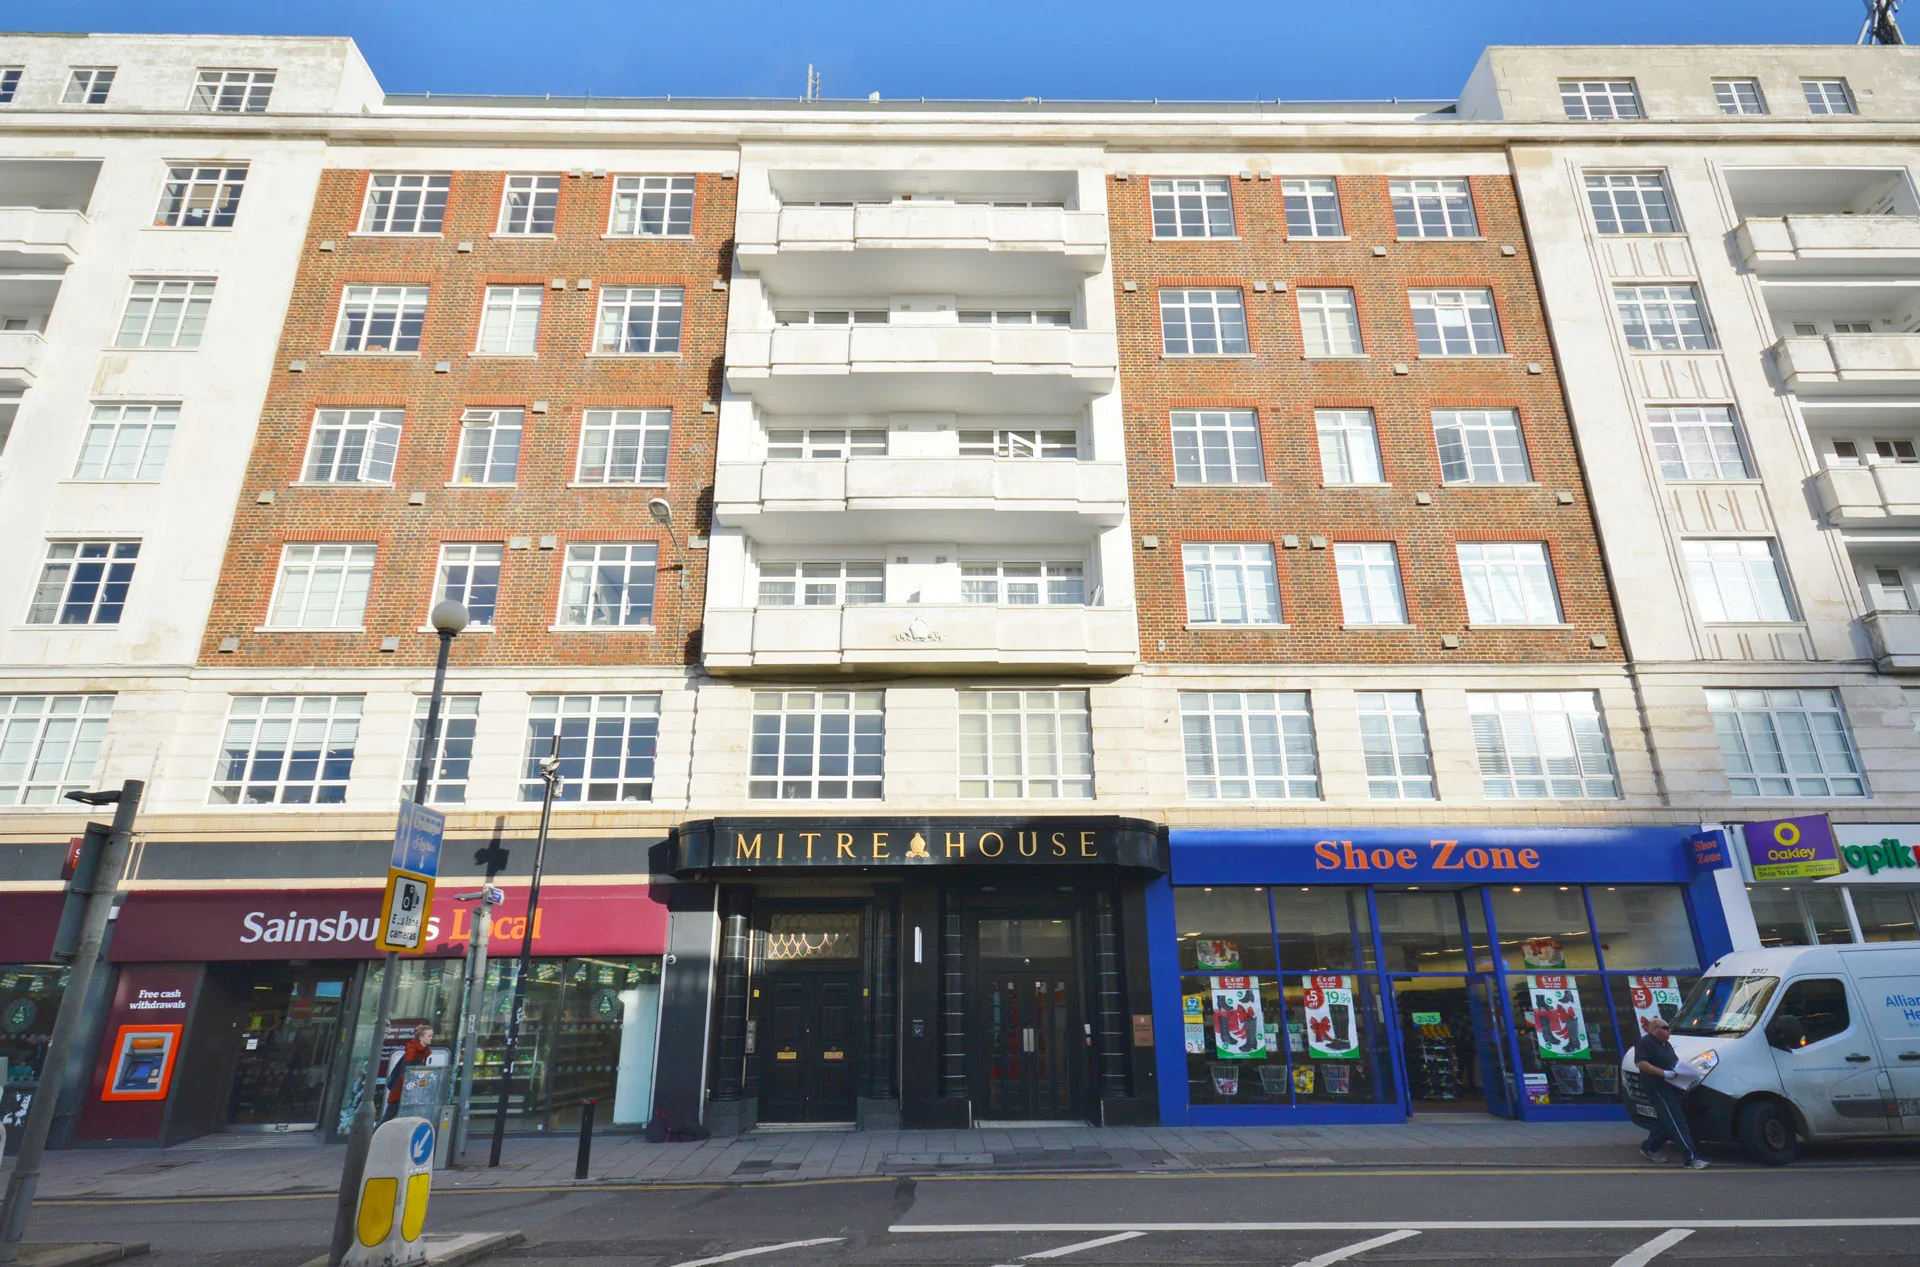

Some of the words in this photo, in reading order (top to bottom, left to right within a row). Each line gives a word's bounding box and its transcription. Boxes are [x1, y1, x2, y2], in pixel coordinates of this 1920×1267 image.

[736, 832, 890, 860] MITRE
[944, 831, 1099, 859] HOUSE
[1694, 840, 1719, 851] Shoe
[1314, 840, 1418, 870] Shoe
[1429, 840, 1540, 869] Zone
[1696, 852, 1722, 865] Zone
[1767, 847, 1816, 861] Oakley
[1758, 870, 1777, 878] Shop
[240, 910, 440, 943] Sainsbus
[449, 908, 543, 941] Lcal
[138, 989, 159, 999] Free
[160, 989, 182, 998] cash
[129, 1000, 187, 1010] withdrawals
